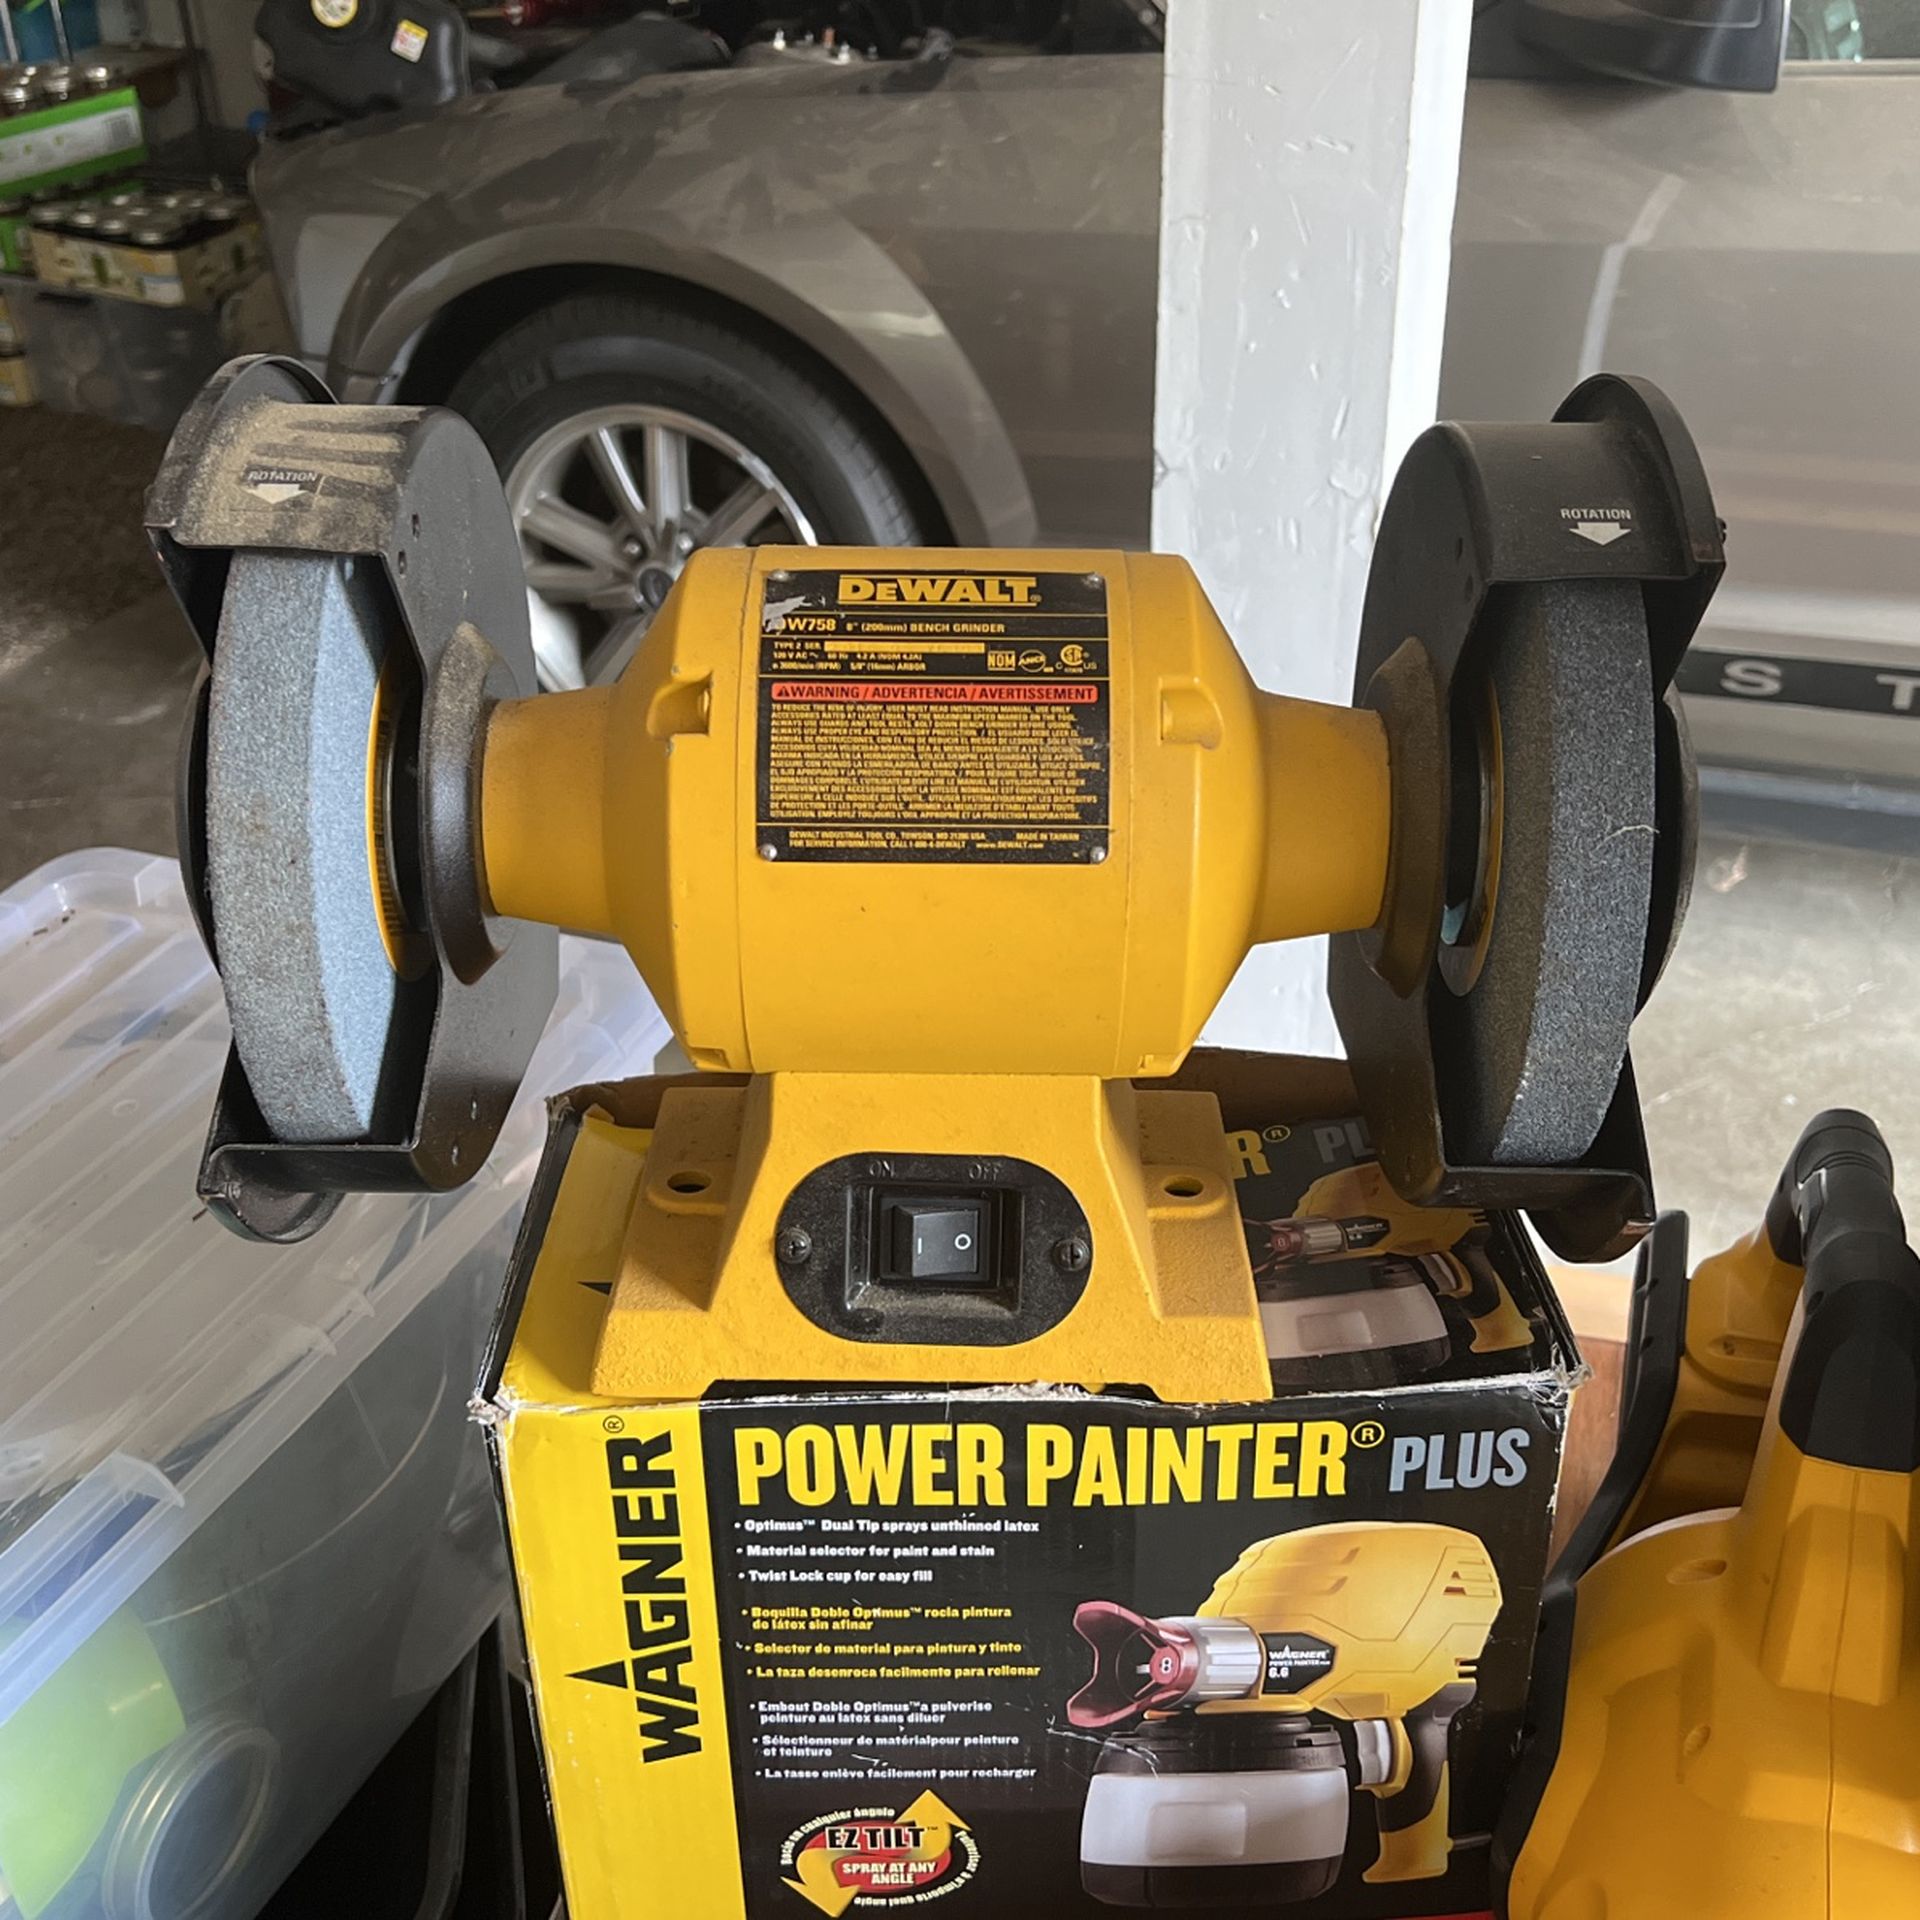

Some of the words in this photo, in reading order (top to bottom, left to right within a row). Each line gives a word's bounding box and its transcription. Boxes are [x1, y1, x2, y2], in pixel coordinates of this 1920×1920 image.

[248, 470, 318, 482] ROTATION
[1560, 508, 1631, 519] ROTATION
[910, 623, 950, 633] BENCH
[953, 623, 1006, 634] GRINDER
[774, 641, 794, 650] TYPE
[987, 652, 1016, 669] NOM
[1720, 659, 1782, 696] S
[1875, 673, 1920, 710] T
[790, 686, 860, 699] WARNING
[872, 686, 967, 699] ADVERTENCIA
[979, 687, 1094, 701] AVERTISSEMENT
[869, 1160, 896, 1179] ON
[734, 1423, 1007, 1507] POWER
[1389, 1428, 1531, 1492] PLUS
[821, 1519, 854, 1532] Dual
[856, 1519, 880, 1534] Tip
[882, 1521, 928, 1534] sprays
[930, 1519, 1001, 1532] unthinned
[1004, 1519, 1040, 1532] latex
[746, 1545, 807, 1557] Material
[809, 1545, 866, 1557] selector
[868, 1545, 890, 1557] for
[893, 1545, 929, 1559] paint
[931, 1545, 958, 1557] and
[960, 1545, 995, 1557] stain
[748, 1570, 788, 1583] Twist
[789, 1570, 824, 1582] Lock
[826, 1573, 851, 1585] cup
[854, 1570, 876, 1582] for
[878, 1572, 910, 1584] easy
[911, 1570, 933, 1582] fill
[751, 1607, 808, 1619] Boquilla
[811, 1607, 850, 1618] Doble
[962, 1606, 1013, 1620] pintura
[752, 1619, 769, 1630] de
[808, 1619, 829, 1630] sin
[832, 1619, 874, 1630] afinar
[754, 1643, 812, 1654] Selector
[814, 1643, 831, 1654] de
[834, 1643, 891, 1654] material
[893, 1645, 924, 1656] para
[927, 1643, 977, 1656] pintura
[978, 1645, 987, 1656] y
[756, 1666, 774, 1678] La
[776, 1667, 806, 1678] taza
[808, 1667, 877, 1678] desenroca
[954, 1668, 985, 1679] para
[987, 1665, 1041, 1677] rellenar
[758, 1701, 810, 1712] Embout
[812, 1701, 851, 1712] Doble
[931, 1701, 992, 1713] pulverise
[760, 1713, 816, 1725] peinture
[819, 1714, 835, 1723] au
[838, 1713, 871, 1723] latex
[874, 1714, 904, 1723] sans
[907, 1713, 946, 1723] diluer
[761, 1735, 854, 1745] Sélectionneur
[857, 1735, 873, 1745] de
[964, 1735, 1020, 1748] peinture
[763, 1748, 777, 1757] et
[780, 1747, 833, 1757] teinture
[765, 1768, 782, 1778] La
[784, 1768, 820, 1778] tasse
[867, 1768, 937, 1779] facilement
[939, 1769, 970, 1780] pour
[972, 1767, 1037, 1779] recharger
[825, 1826, 862, 1850] EZ
[842, 1862, 887, 1874] SPRAY
[889, 1862, 908, 1873] AT
[909, 1862, 937, 1873] ANY
[871, 1873, 914, 1885] ANGLE
